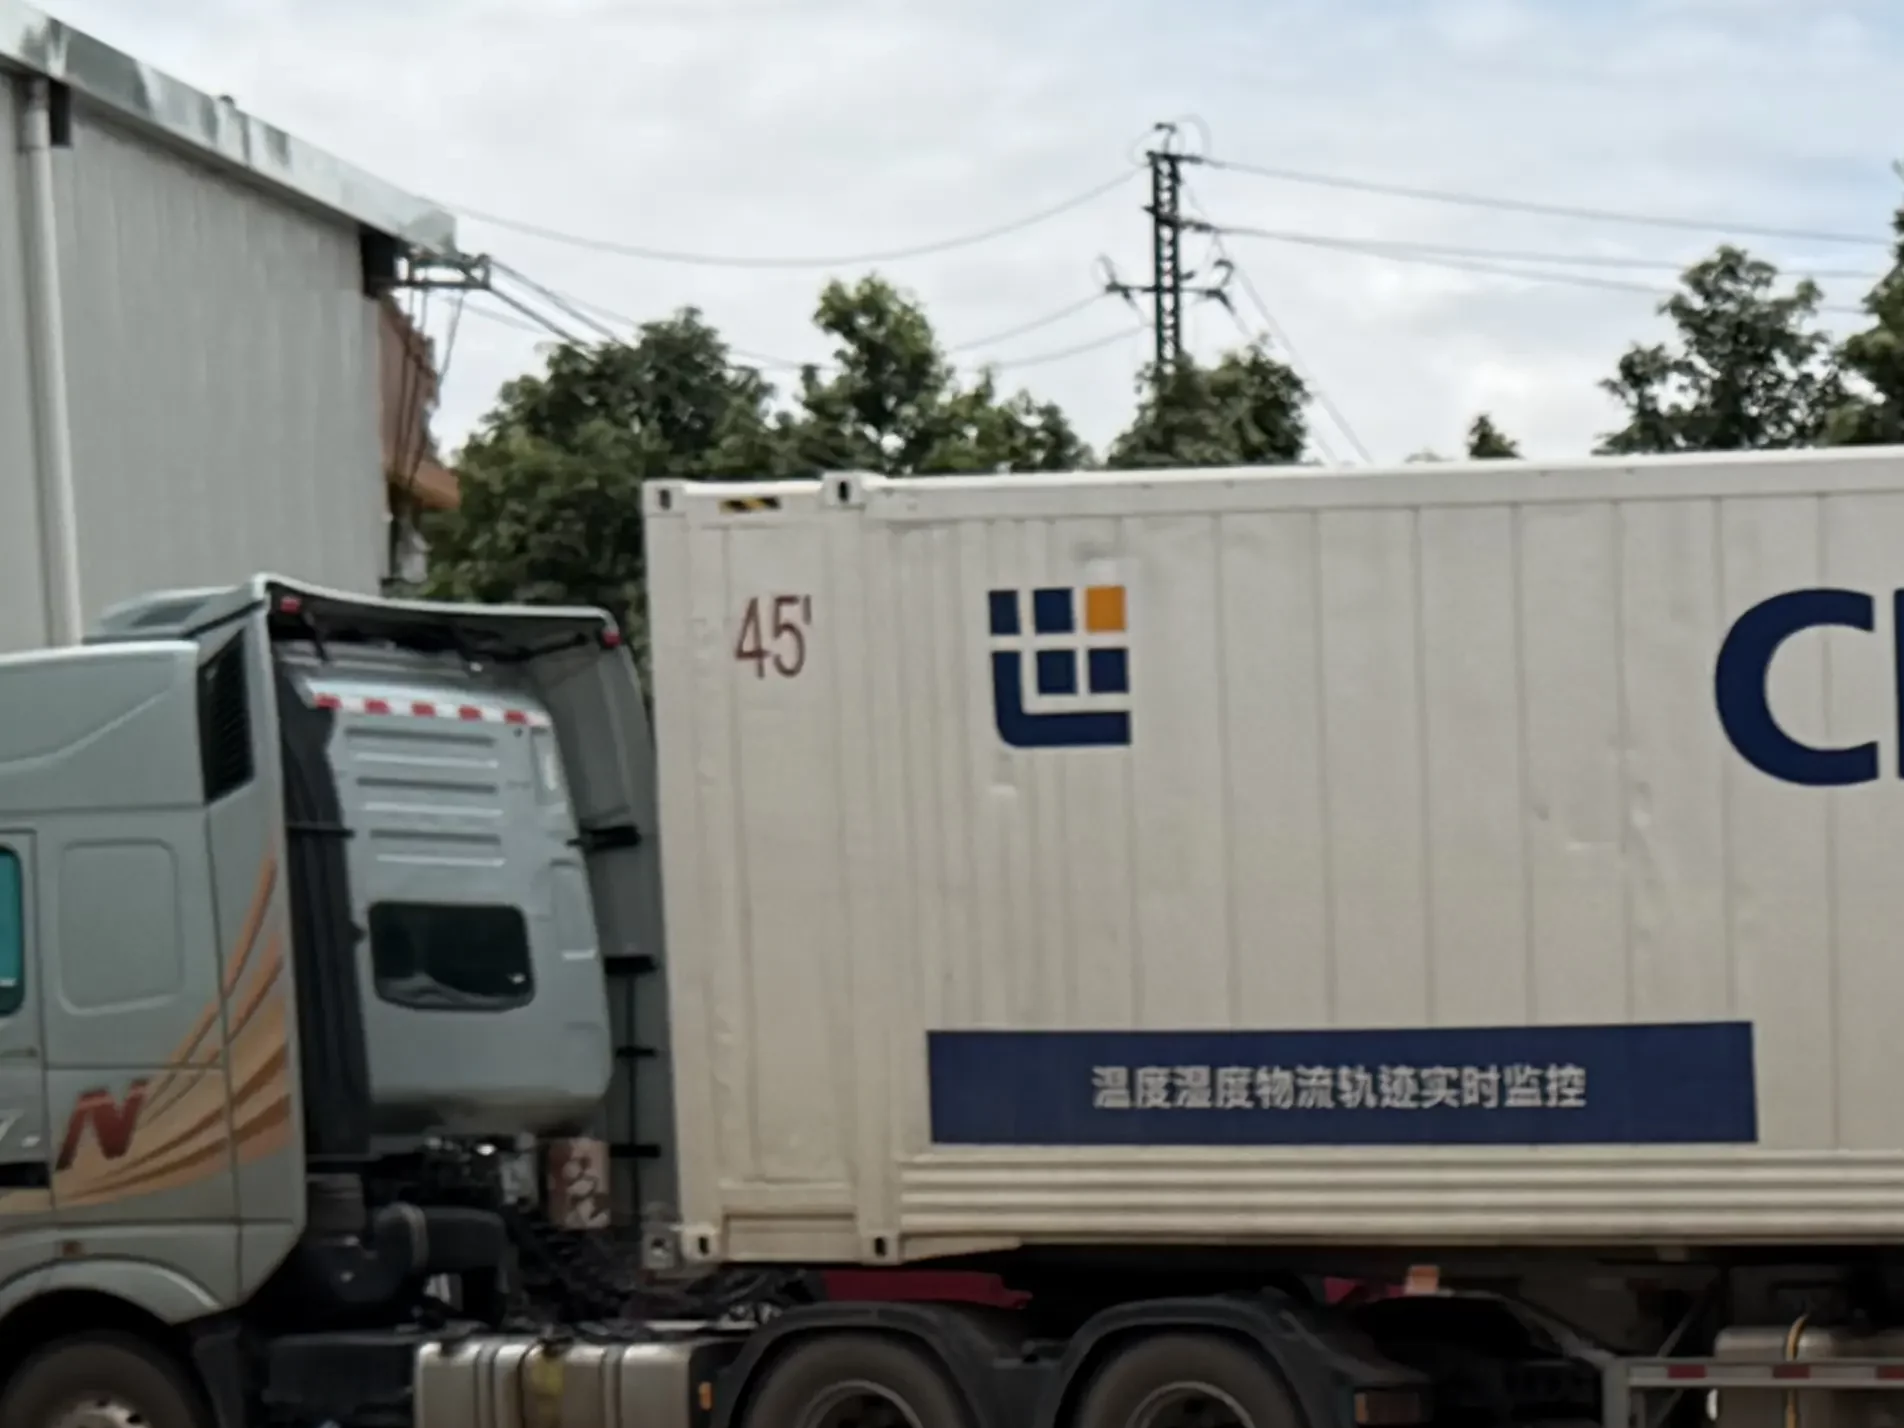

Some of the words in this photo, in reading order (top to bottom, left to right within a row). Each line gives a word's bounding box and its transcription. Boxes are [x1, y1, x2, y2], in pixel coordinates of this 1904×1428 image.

[1092, 1063, 1588, 1111] 温度湿度物流轨迹实时监控
